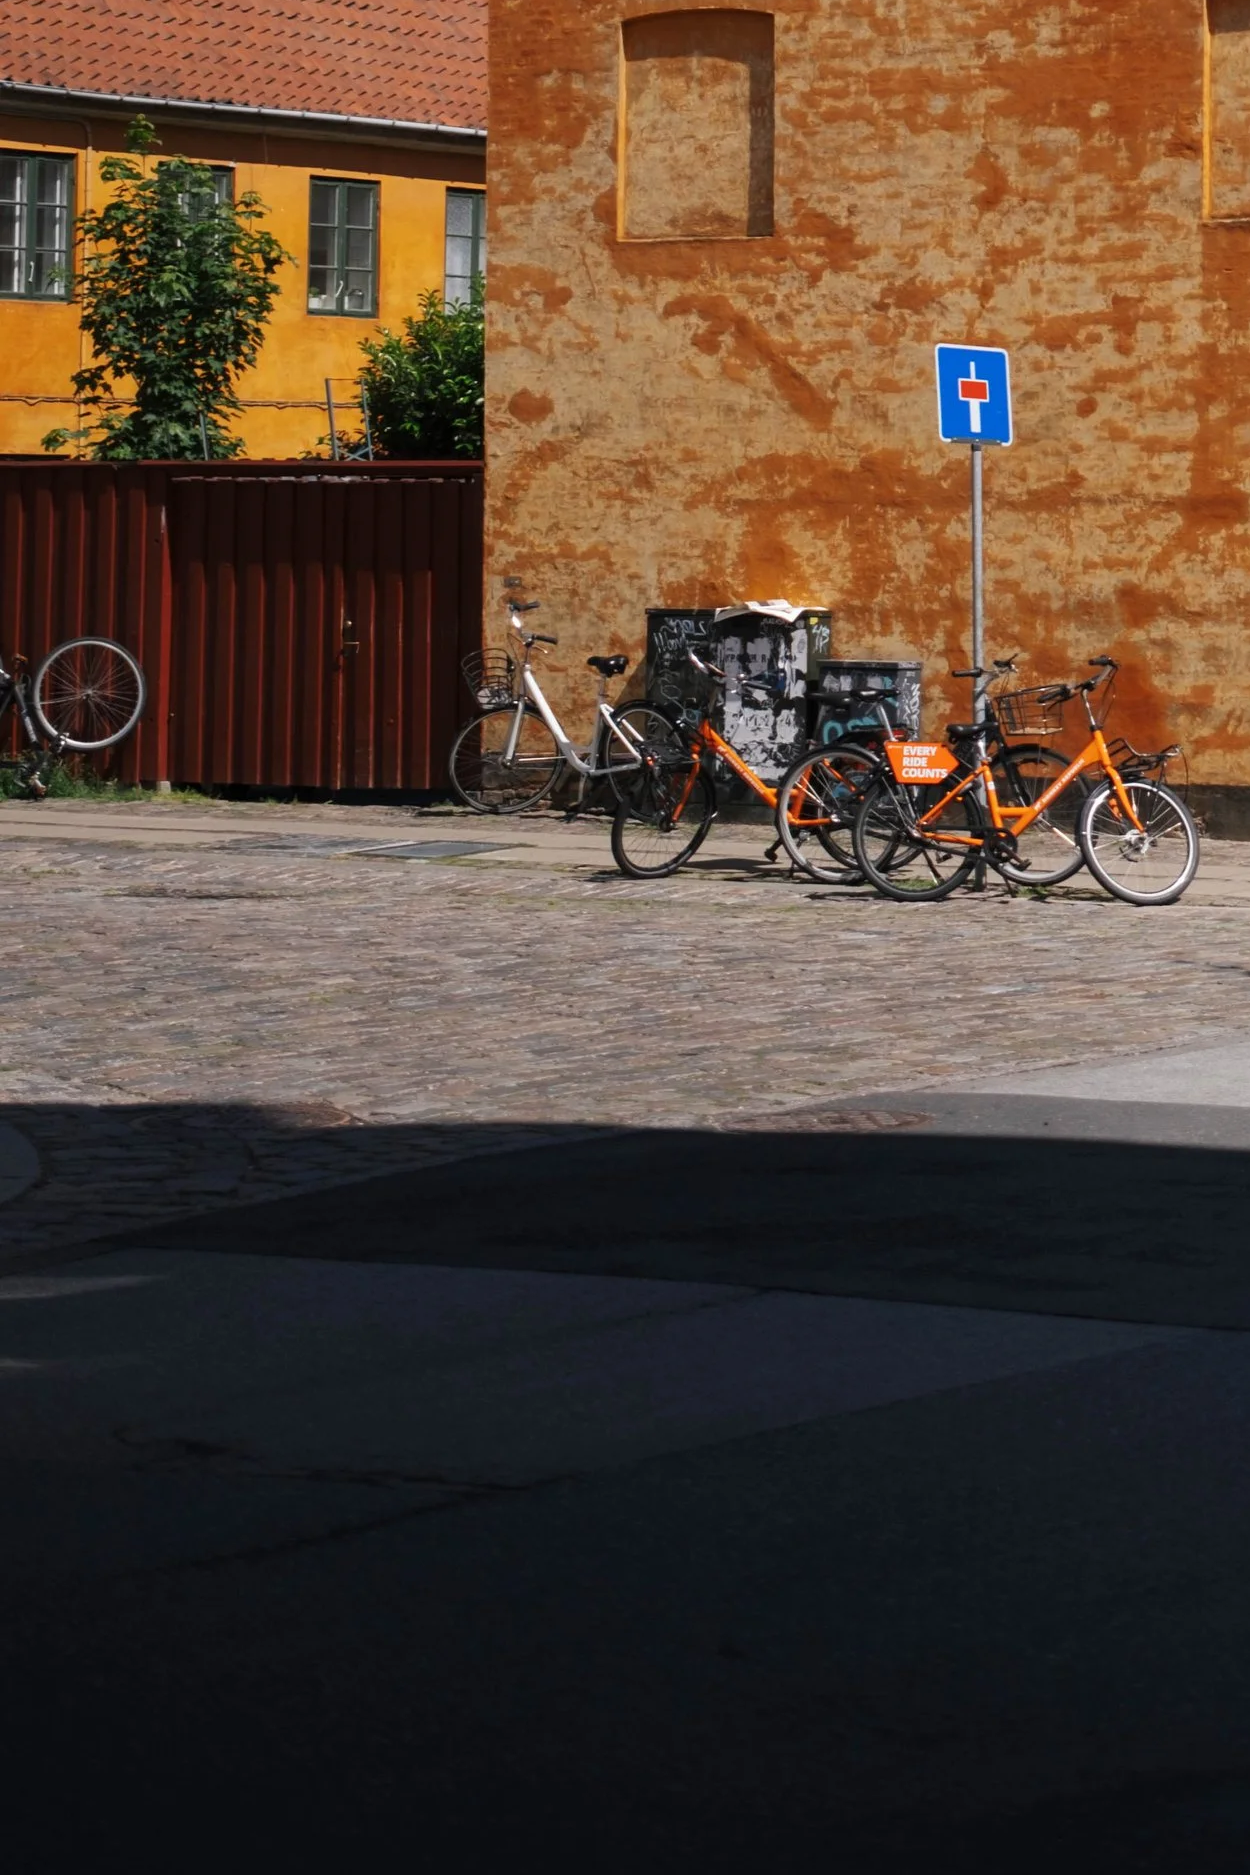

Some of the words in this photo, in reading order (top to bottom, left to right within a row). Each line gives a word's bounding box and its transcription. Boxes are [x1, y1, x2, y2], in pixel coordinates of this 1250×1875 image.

[903, 745, 937, 756] EVERY
[902, 756, 928, 767] RIDE
[901, 768, 948, 778] COUNTS
